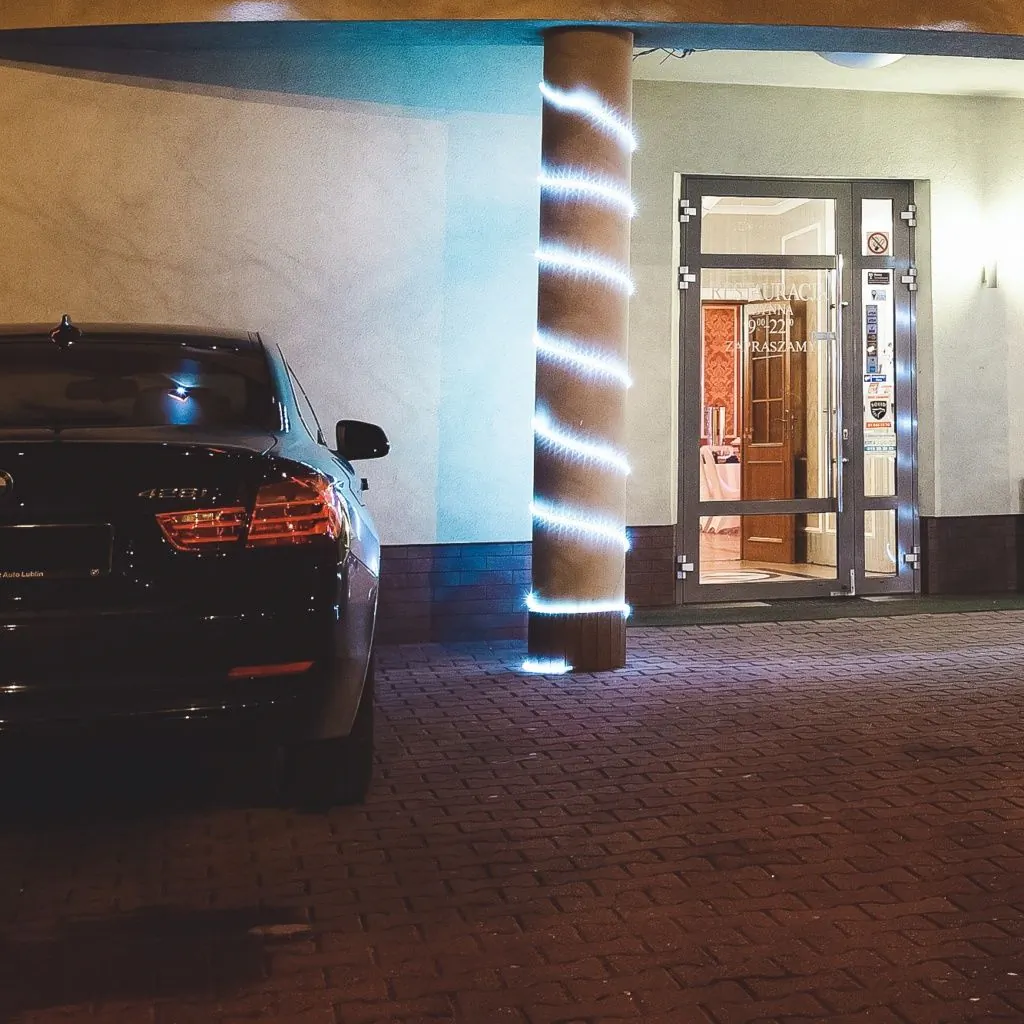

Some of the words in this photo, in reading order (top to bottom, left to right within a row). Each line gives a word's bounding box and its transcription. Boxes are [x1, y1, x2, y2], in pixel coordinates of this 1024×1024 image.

[711, 282, 829, 301] RESTAURACJ
[748, 303, 794, 316] YNNA
[725, 340, 817, 353] ZAPRASZAMY
